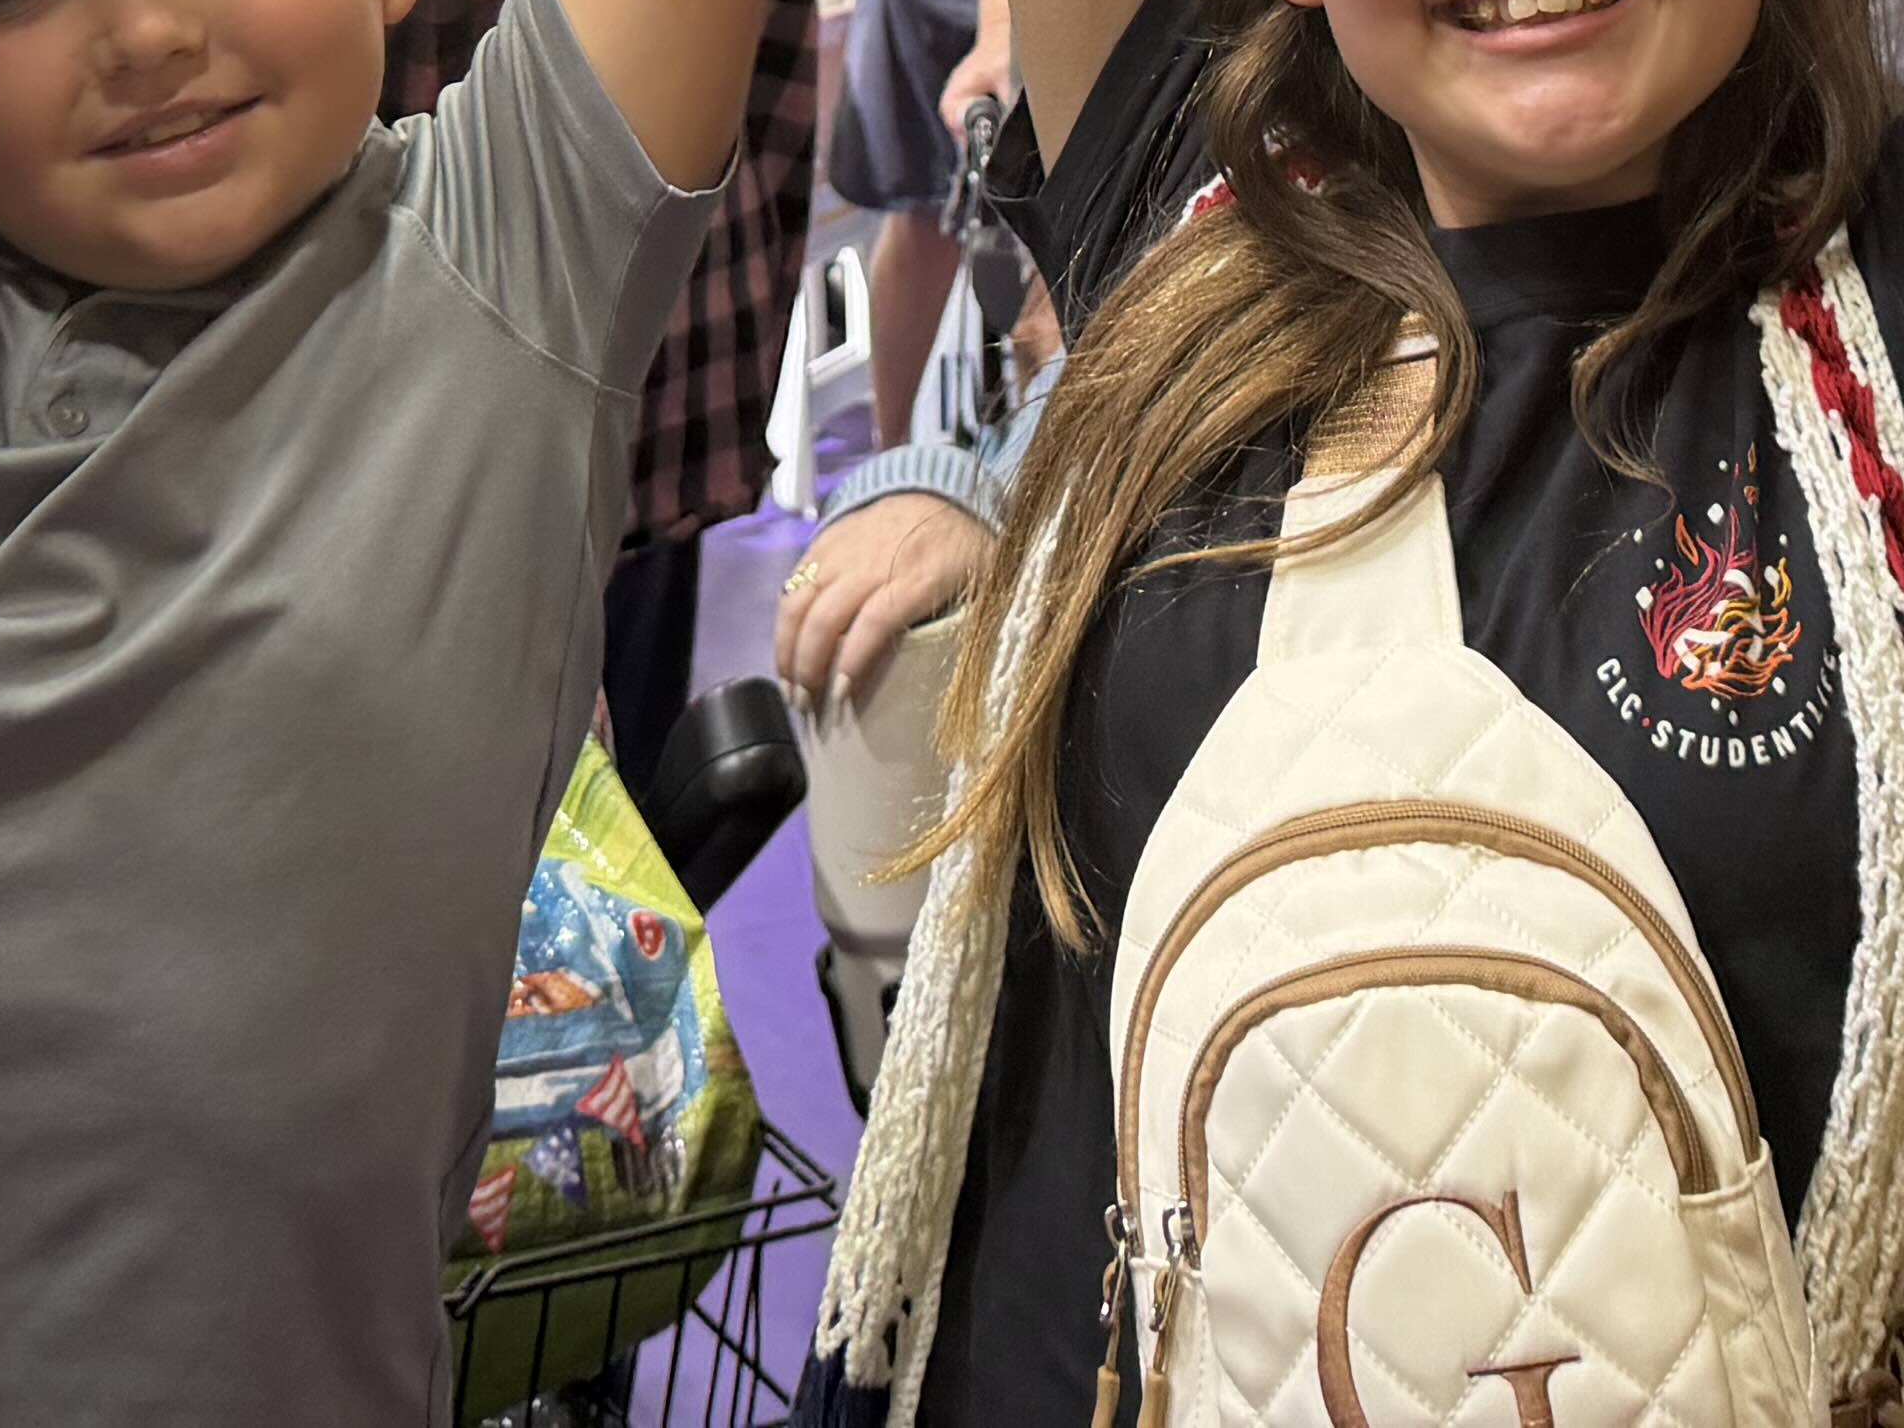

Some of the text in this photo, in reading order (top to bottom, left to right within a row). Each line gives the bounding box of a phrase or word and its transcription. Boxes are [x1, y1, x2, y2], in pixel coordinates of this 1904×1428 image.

[1597, 658, 1643, 721] CLC
[1651, 710, 1814, 769] STUDENT
[1318, 1187, 1582, 1428] G
